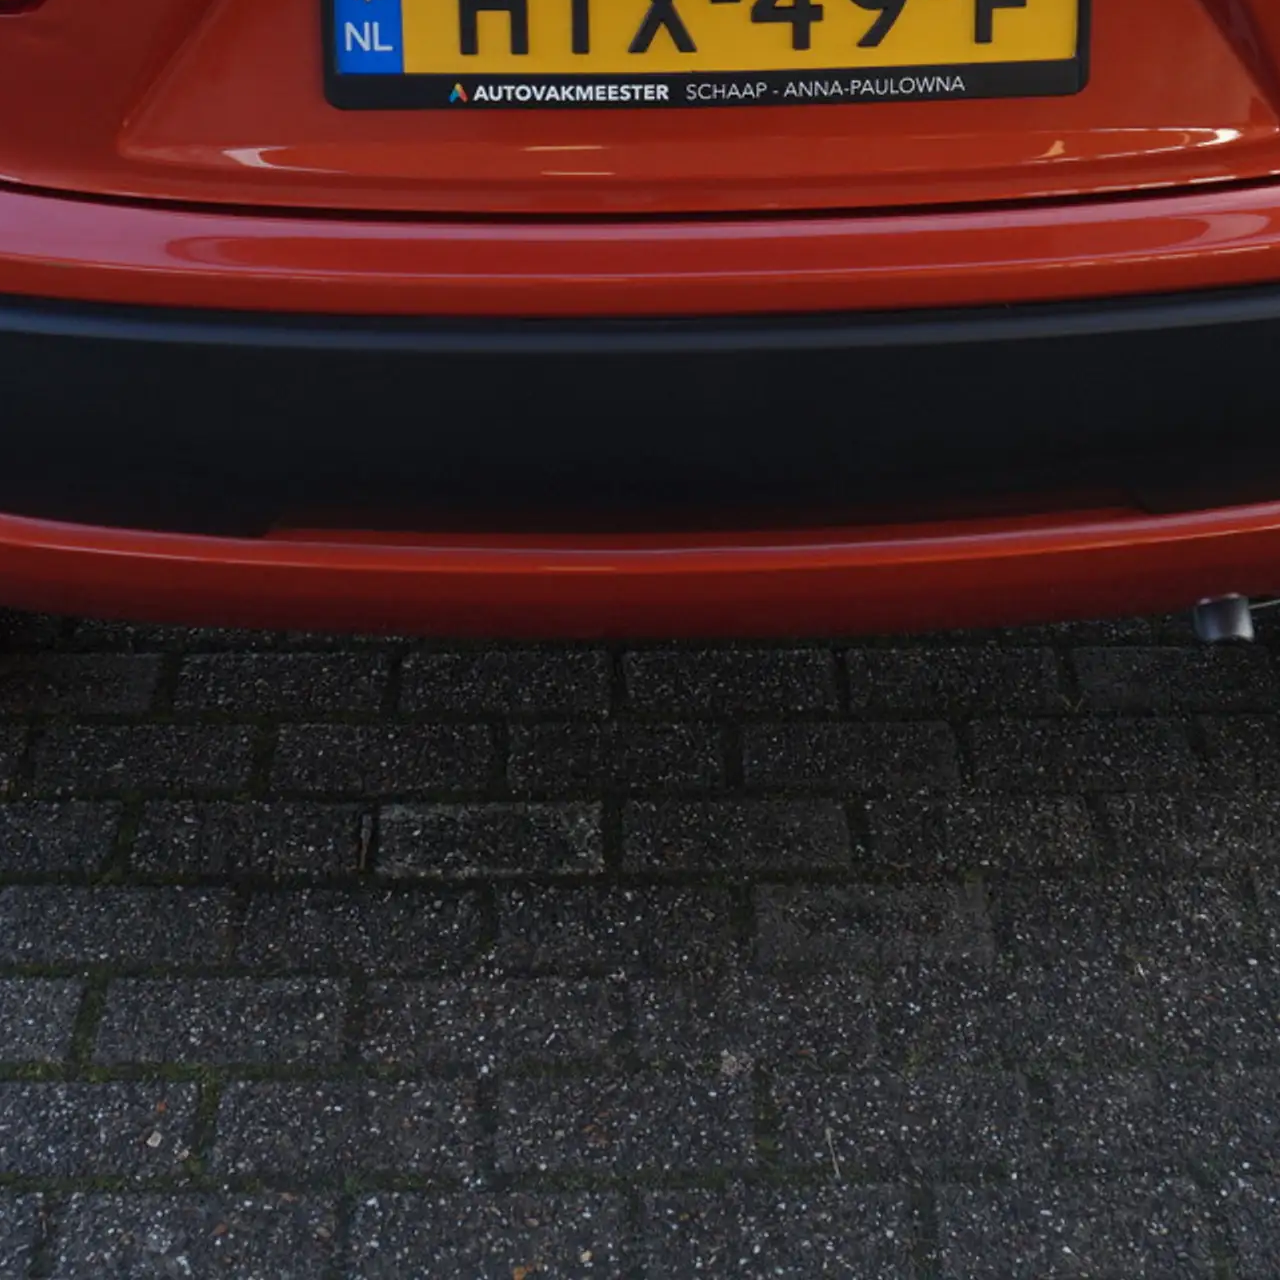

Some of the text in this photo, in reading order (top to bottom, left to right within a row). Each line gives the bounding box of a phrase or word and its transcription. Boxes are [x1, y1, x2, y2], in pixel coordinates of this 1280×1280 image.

[344, 21, 394, 53] NL
[472, 83, 670, 103] AUTOVAKMEESTER
[685, 81, 768, 101] SCHAAP
[783, 75, 967, 99] ANNA-PAULOWNA
